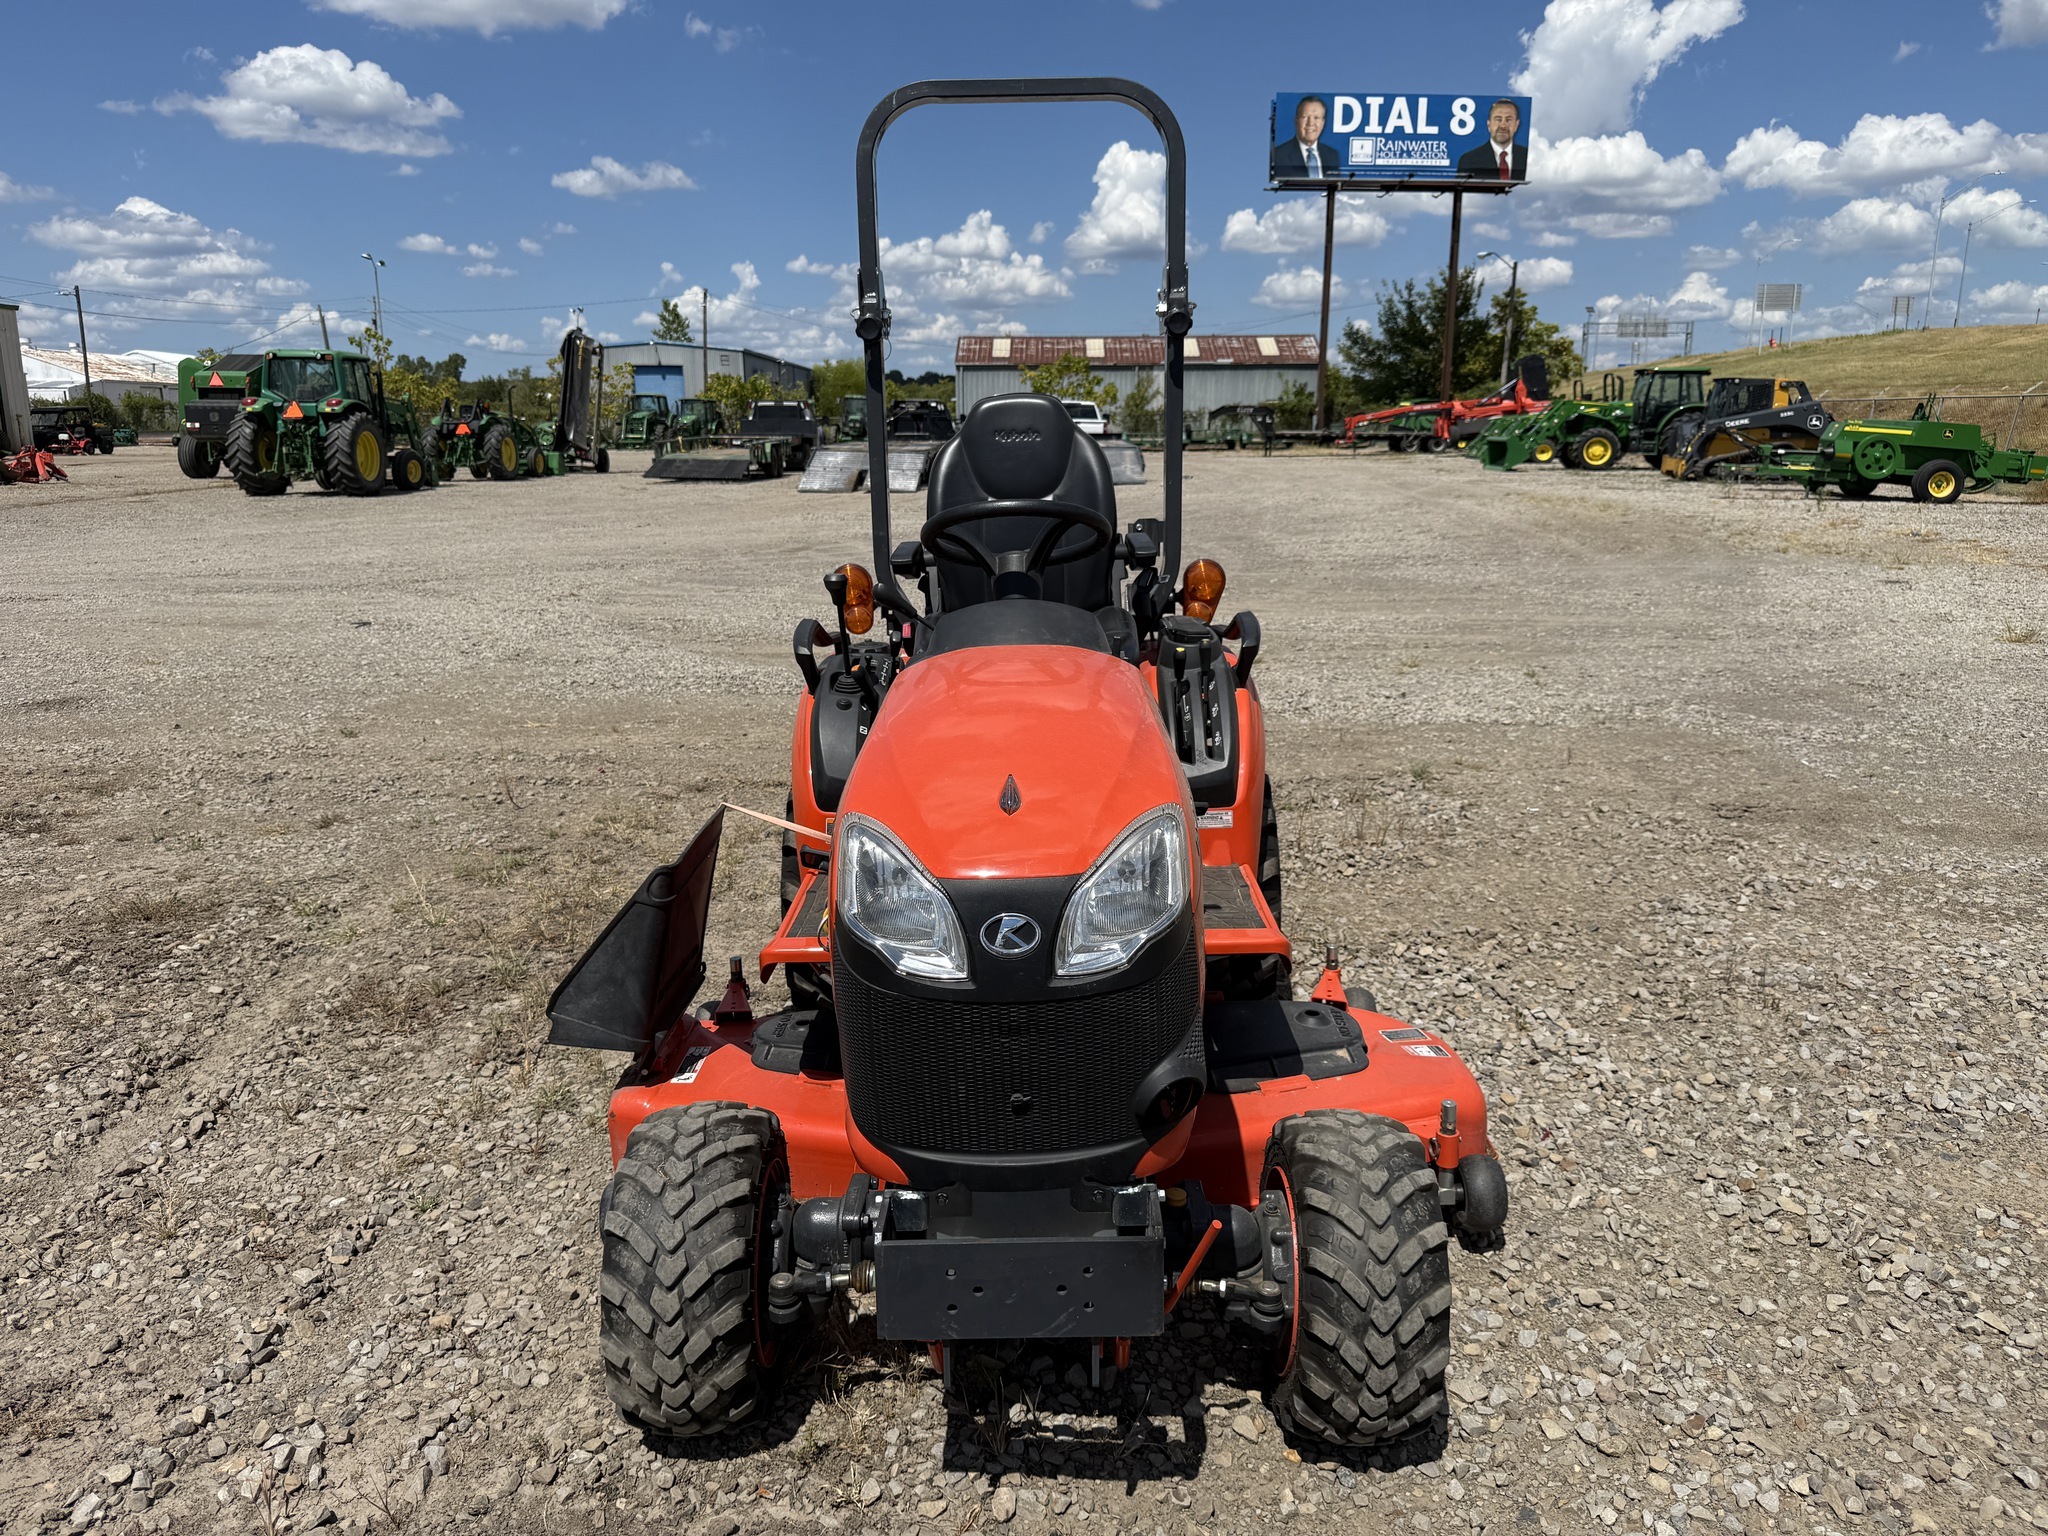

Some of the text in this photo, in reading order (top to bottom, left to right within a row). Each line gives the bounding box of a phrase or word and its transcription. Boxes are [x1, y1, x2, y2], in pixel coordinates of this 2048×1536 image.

[1332, 96, 1476, 136] DIAL 8
[1376, 137, 1447, 152] RAINWATER
[1376, 151, 1401, 159] HOLT
[1725, 418, 1750, 427] DEERE
[994, 430, 1041, 443] Kubota
